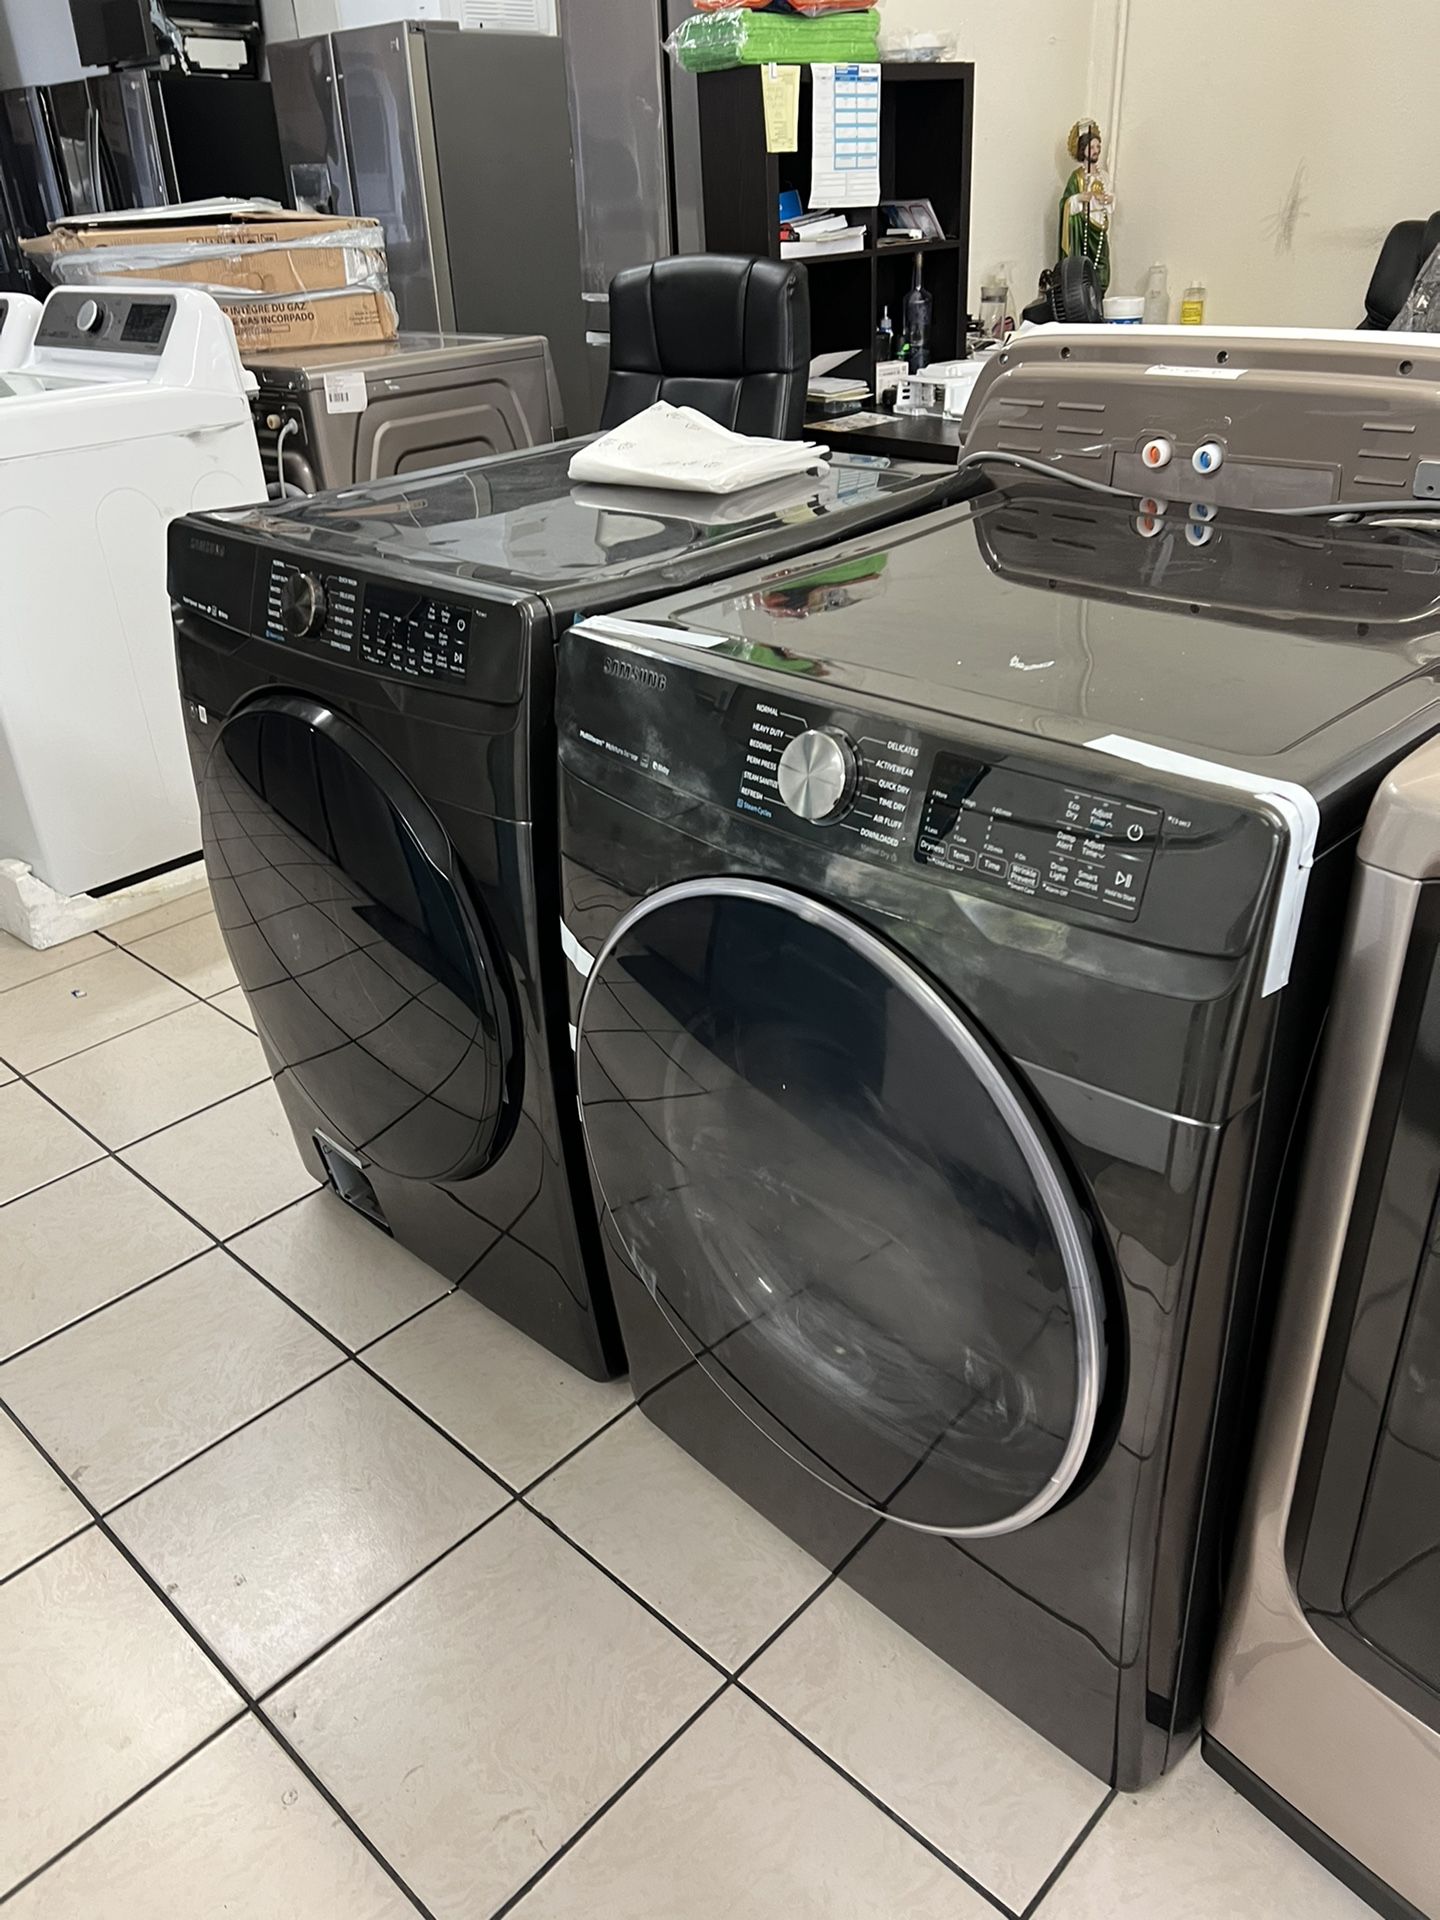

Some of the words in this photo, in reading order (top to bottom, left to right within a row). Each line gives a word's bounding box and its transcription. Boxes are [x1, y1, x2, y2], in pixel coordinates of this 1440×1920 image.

[271, 303, 285, 312] DU
[287, 302, 306, 312] GAZ
[240, 316, 260, 326] GAS
[261, 312, 315, 325] INCORPADO
[603, 657, 667, 692] SAMSUNG
[756, 703, 778, 717] NORMAL
[752, 722, 770, 734] HEAVY
[770, 727, 785, 738] DUTY
[749, 739, 773, 752] BEDDING
[887, 741, 919, 757] DELICATES
[746, 754, 761, 766] PERM
[761, 759, 777, 771] PRESS
[875, 759, 914, 777] ACTIVEWEAR
[744, 770, 759, 782] STEAM
[741, 786, 763, 800] REFRESH
[878, 779, 897, 791] QUICK
[896, 785, 911, 795] DRY
[879, 797, 893, 809] TIME
[893, 802, 906, 812] DRY
[1068, 801, 1081, 811] Eco
[1065, 810, 1079, 821] Dry
[1091, 808, 1113, 820] Adjust
[873, 814, 884, 825] AIR
[884, 817, 902, 829] FLUFF
[1089, 817, 1105, 827] Time
[860, 828, 899, 847] DOWNLOADED
[1056, 831, 1077, 844] Damp
[920, 840, 945, 855] Dryness
[1055, 840, 1073, 851] Alert
[1083, 839, 1106, 851] Adjust
[1082, 847, 1098, 859] Time
[984, 859, 1001, 872] Time
[1012, 865, 1037, 878] Wrinkle
[1050, 862, 1069, 873] Drum
[1010, 872, 1036, 886] Prevent
[1049, 871, 1067, 882] Light
[1077, 870, 1098, 883] Smart
[1074, 879, 1098, 892] Control
